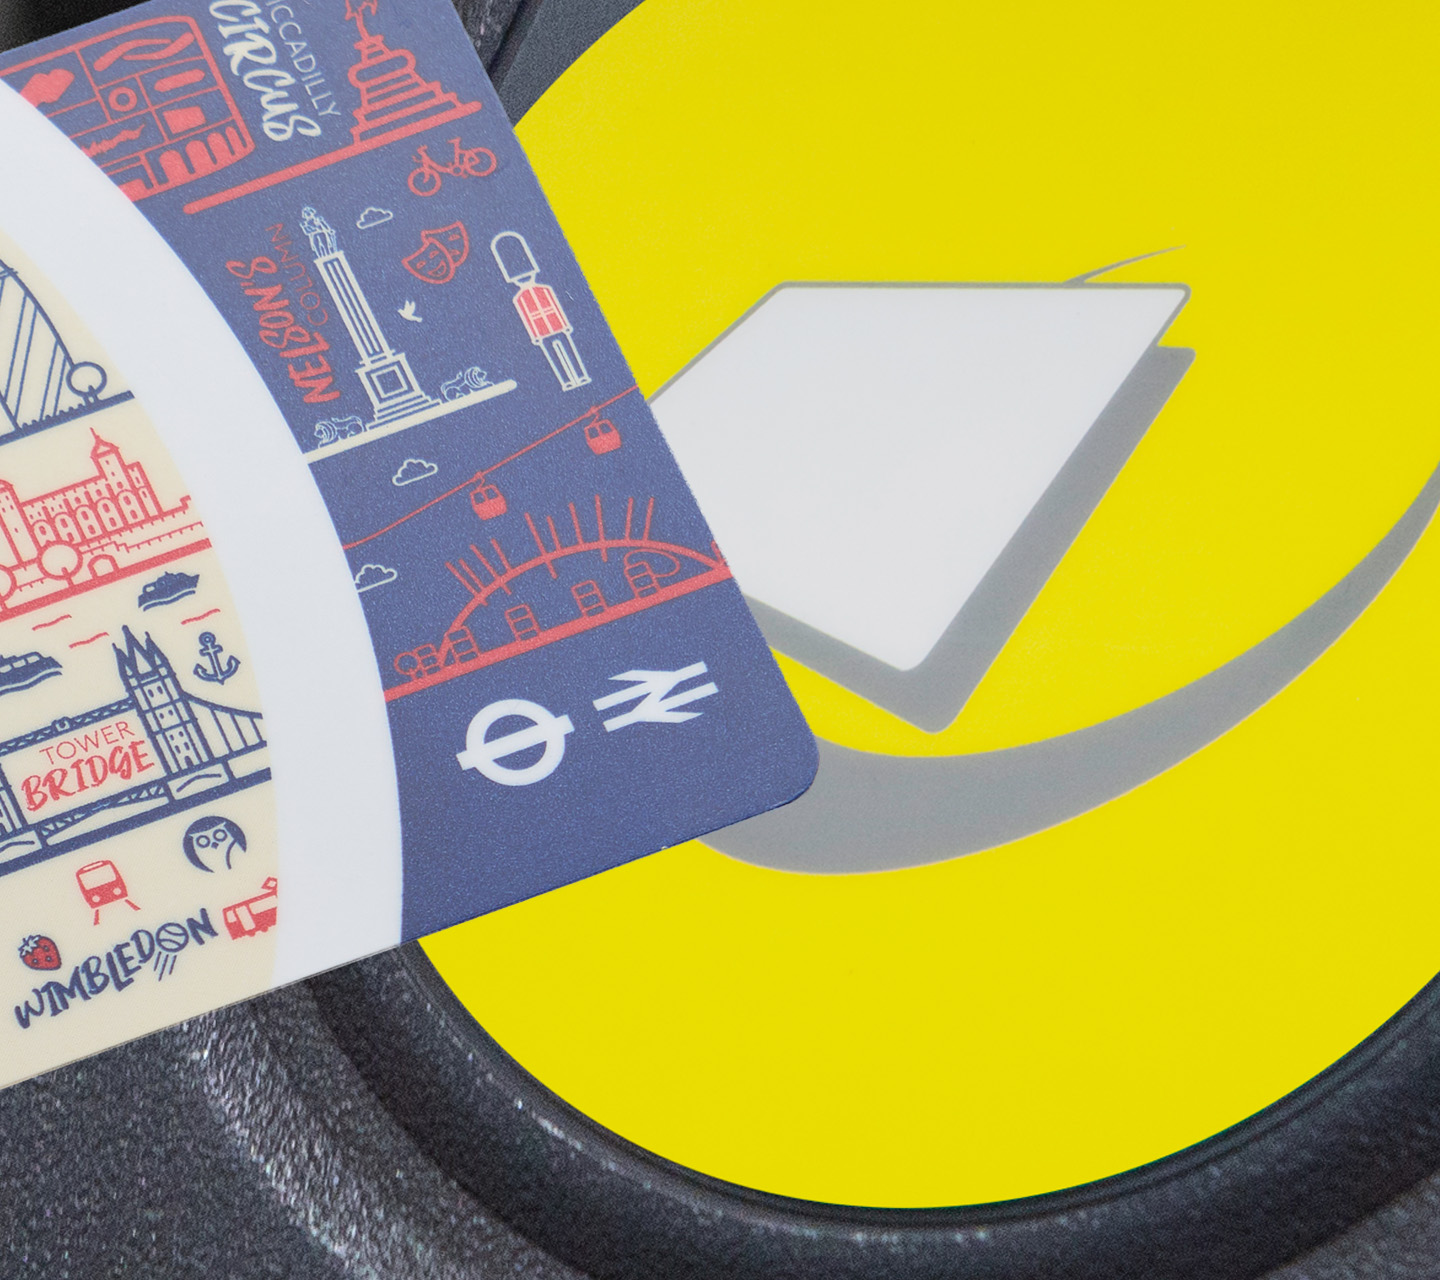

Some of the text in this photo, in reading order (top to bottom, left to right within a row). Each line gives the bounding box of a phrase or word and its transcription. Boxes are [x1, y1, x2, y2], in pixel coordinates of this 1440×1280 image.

[266, 223, 328, 326] COLUMN
[225, 256, 341, 404] NELSON'S
[21, 740, 156, 812] BRIDGE
[39, 721, 135, 765] TOWER
[14, 907, 219, 1031] WIMBLEDON
